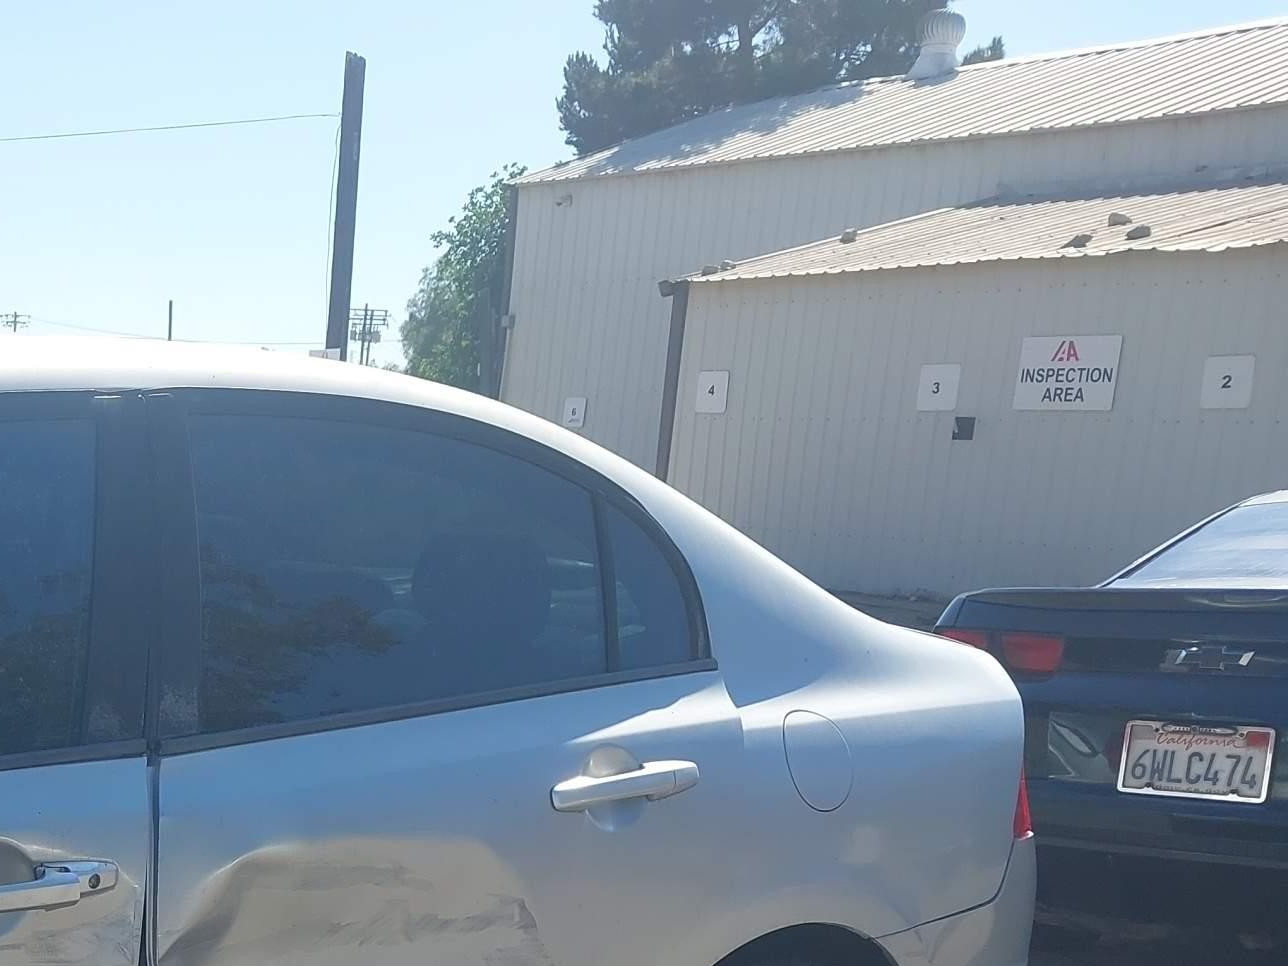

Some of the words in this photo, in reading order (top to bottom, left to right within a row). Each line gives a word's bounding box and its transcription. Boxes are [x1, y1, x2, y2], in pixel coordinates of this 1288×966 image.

[1020, 367, 1114, 383] INSPECTION
[1221, 374, 1232, 389] 2
[707, 384, 715, 396] 4
[932, 382, 940, 394] 3
[1041, 386, 1085, 402] AREA
[1156, 731, 1246, 751] California
[1131, 749, 1257, 789] 6WLC474
